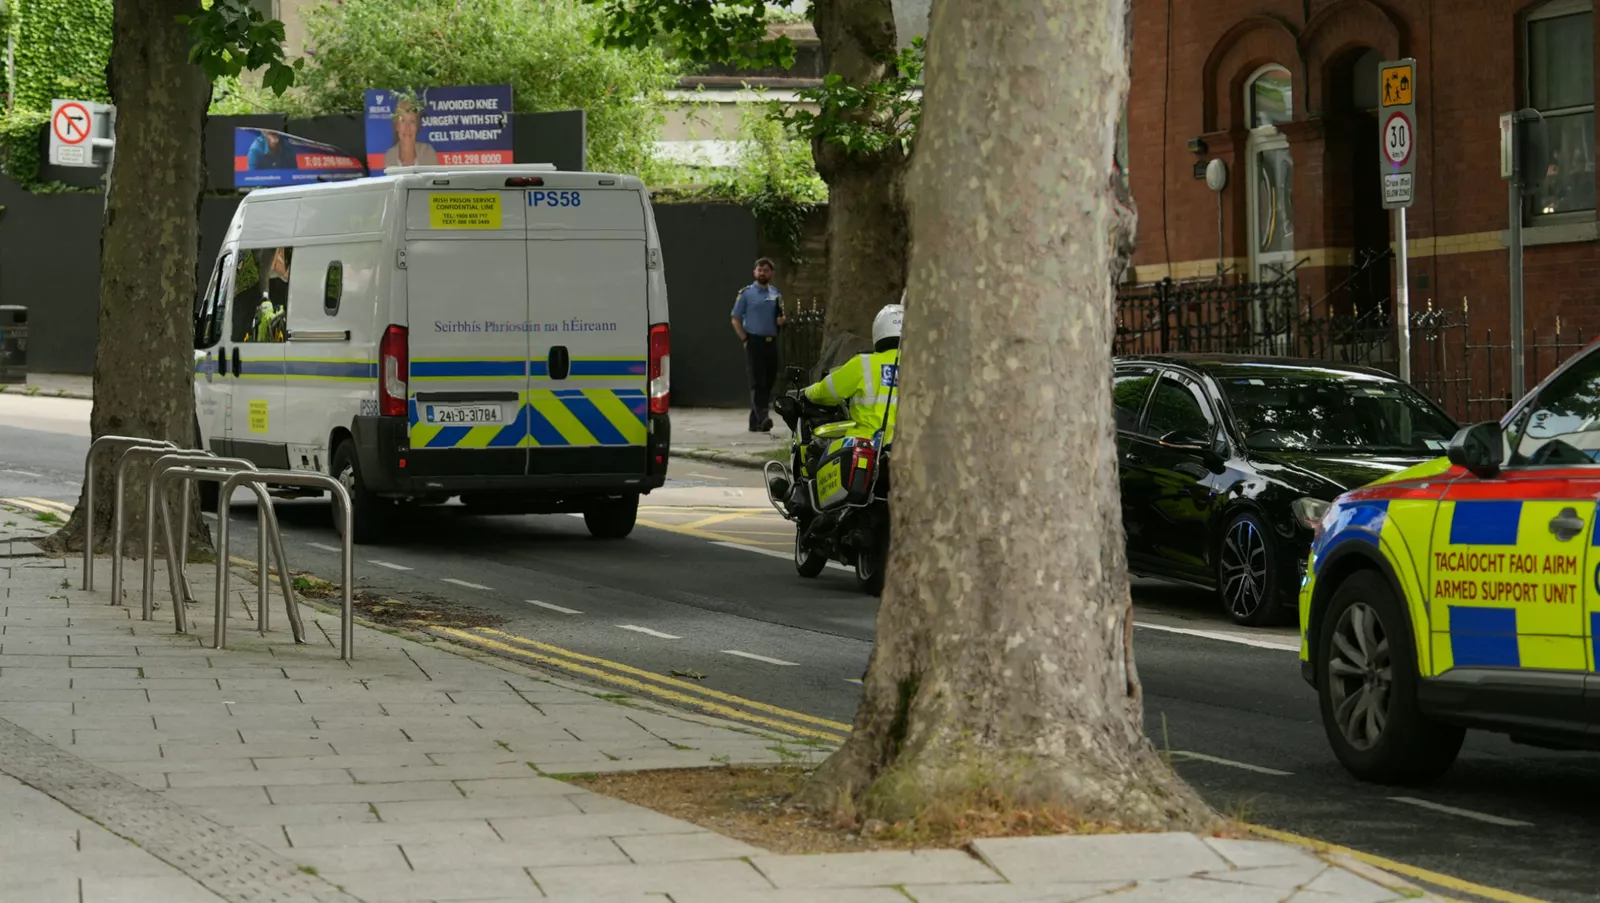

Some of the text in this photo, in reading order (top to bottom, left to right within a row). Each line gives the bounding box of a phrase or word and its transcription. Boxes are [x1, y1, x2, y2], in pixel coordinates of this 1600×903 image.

[439, 100, 475, 110] AVOIDED
[476, 98, 498, 110] KNEE
[421, 115, 459, 127] SURGERY
[460, 114, 484, 125] WITH
[429, 130, 449, 141] CELL
[1391, 125, 1406, 148] 30
[452, 155, 464, 165] 01
[528, 191, 581, 207] IPS58
[1386, 188, 1410, 198] SLOW ZONE
[434, 319, 481, 333] Seirbhís
[544, 322, 558, 332] na
[562, 316, 617, 332] hÉireann
[439, 408, 497, 422] 241-D-31784
[1434, 547, 1577, 575] TACAÍOCHT FAOI AIRM
[1434, 579, 1577, 604] ARMED SUPPORT UNIT
